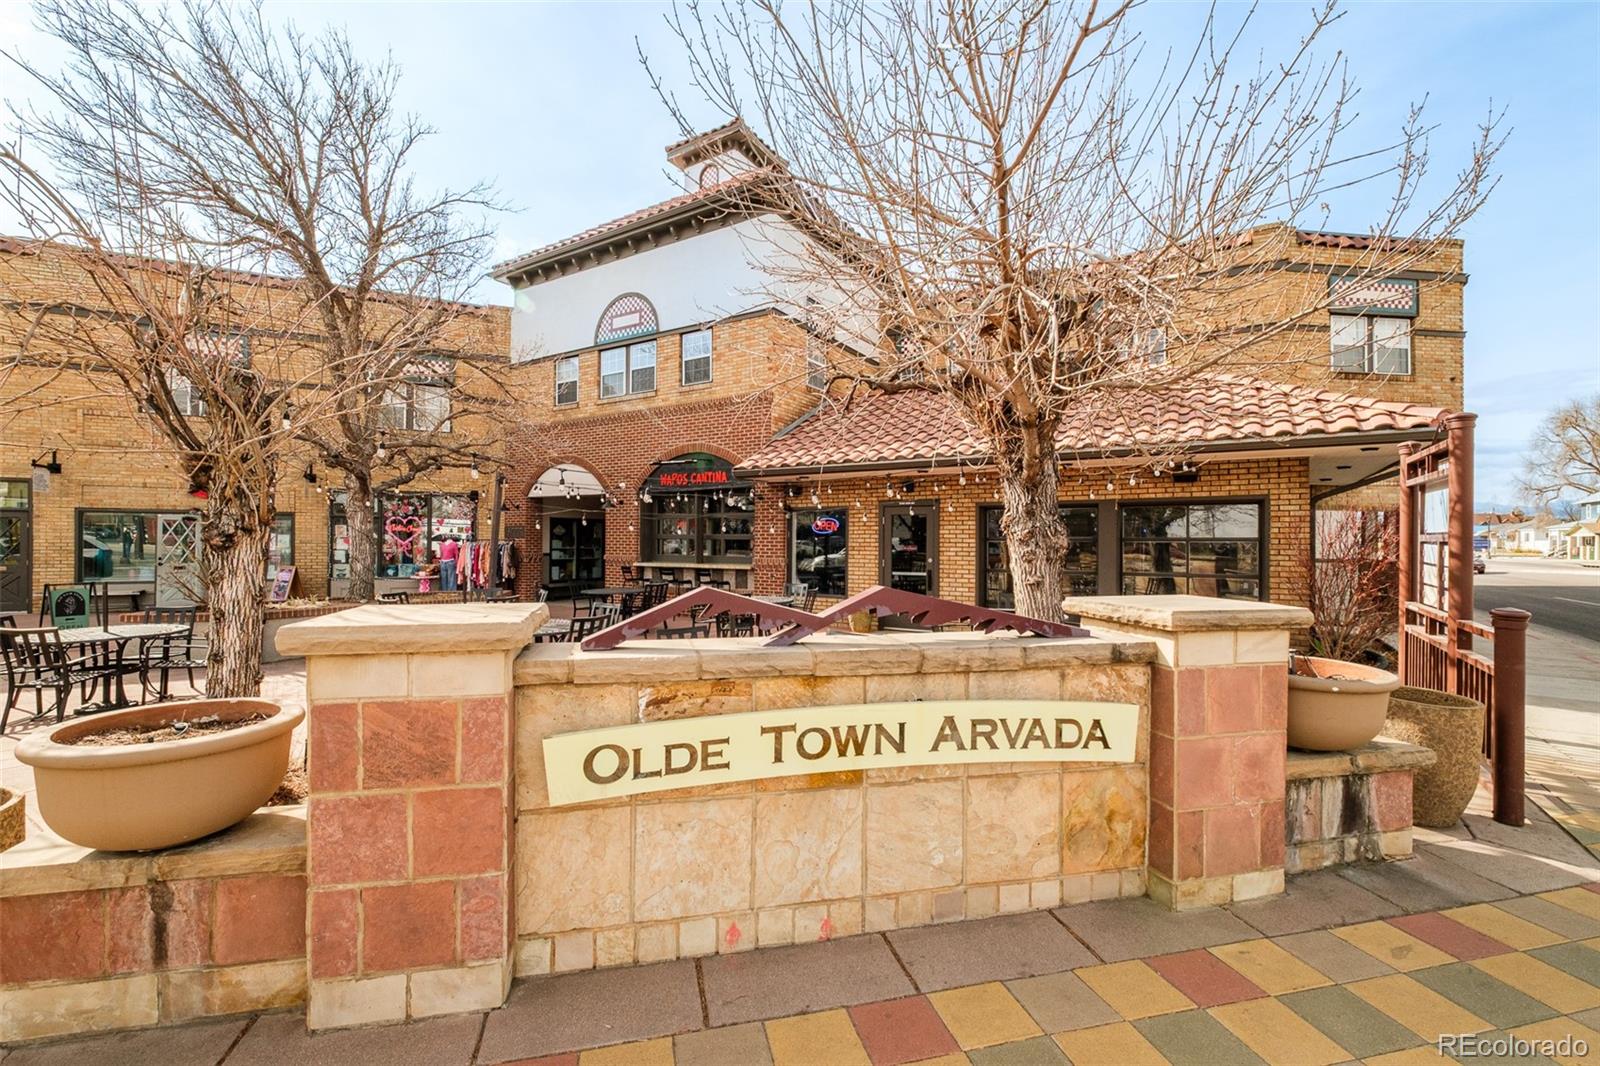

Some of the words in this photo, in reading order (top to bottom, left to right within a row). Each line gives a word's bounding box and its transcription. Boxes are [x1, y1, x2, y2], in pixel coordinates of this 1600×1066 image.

[690, 470, 728, 485] CANTINA
[814, 519, 838, 531] OPEN
[582, 736, 731, 785] OLDE
[760, 721, 907, 763] TOWN
[929, 715, 1112, 752] ARVADA
